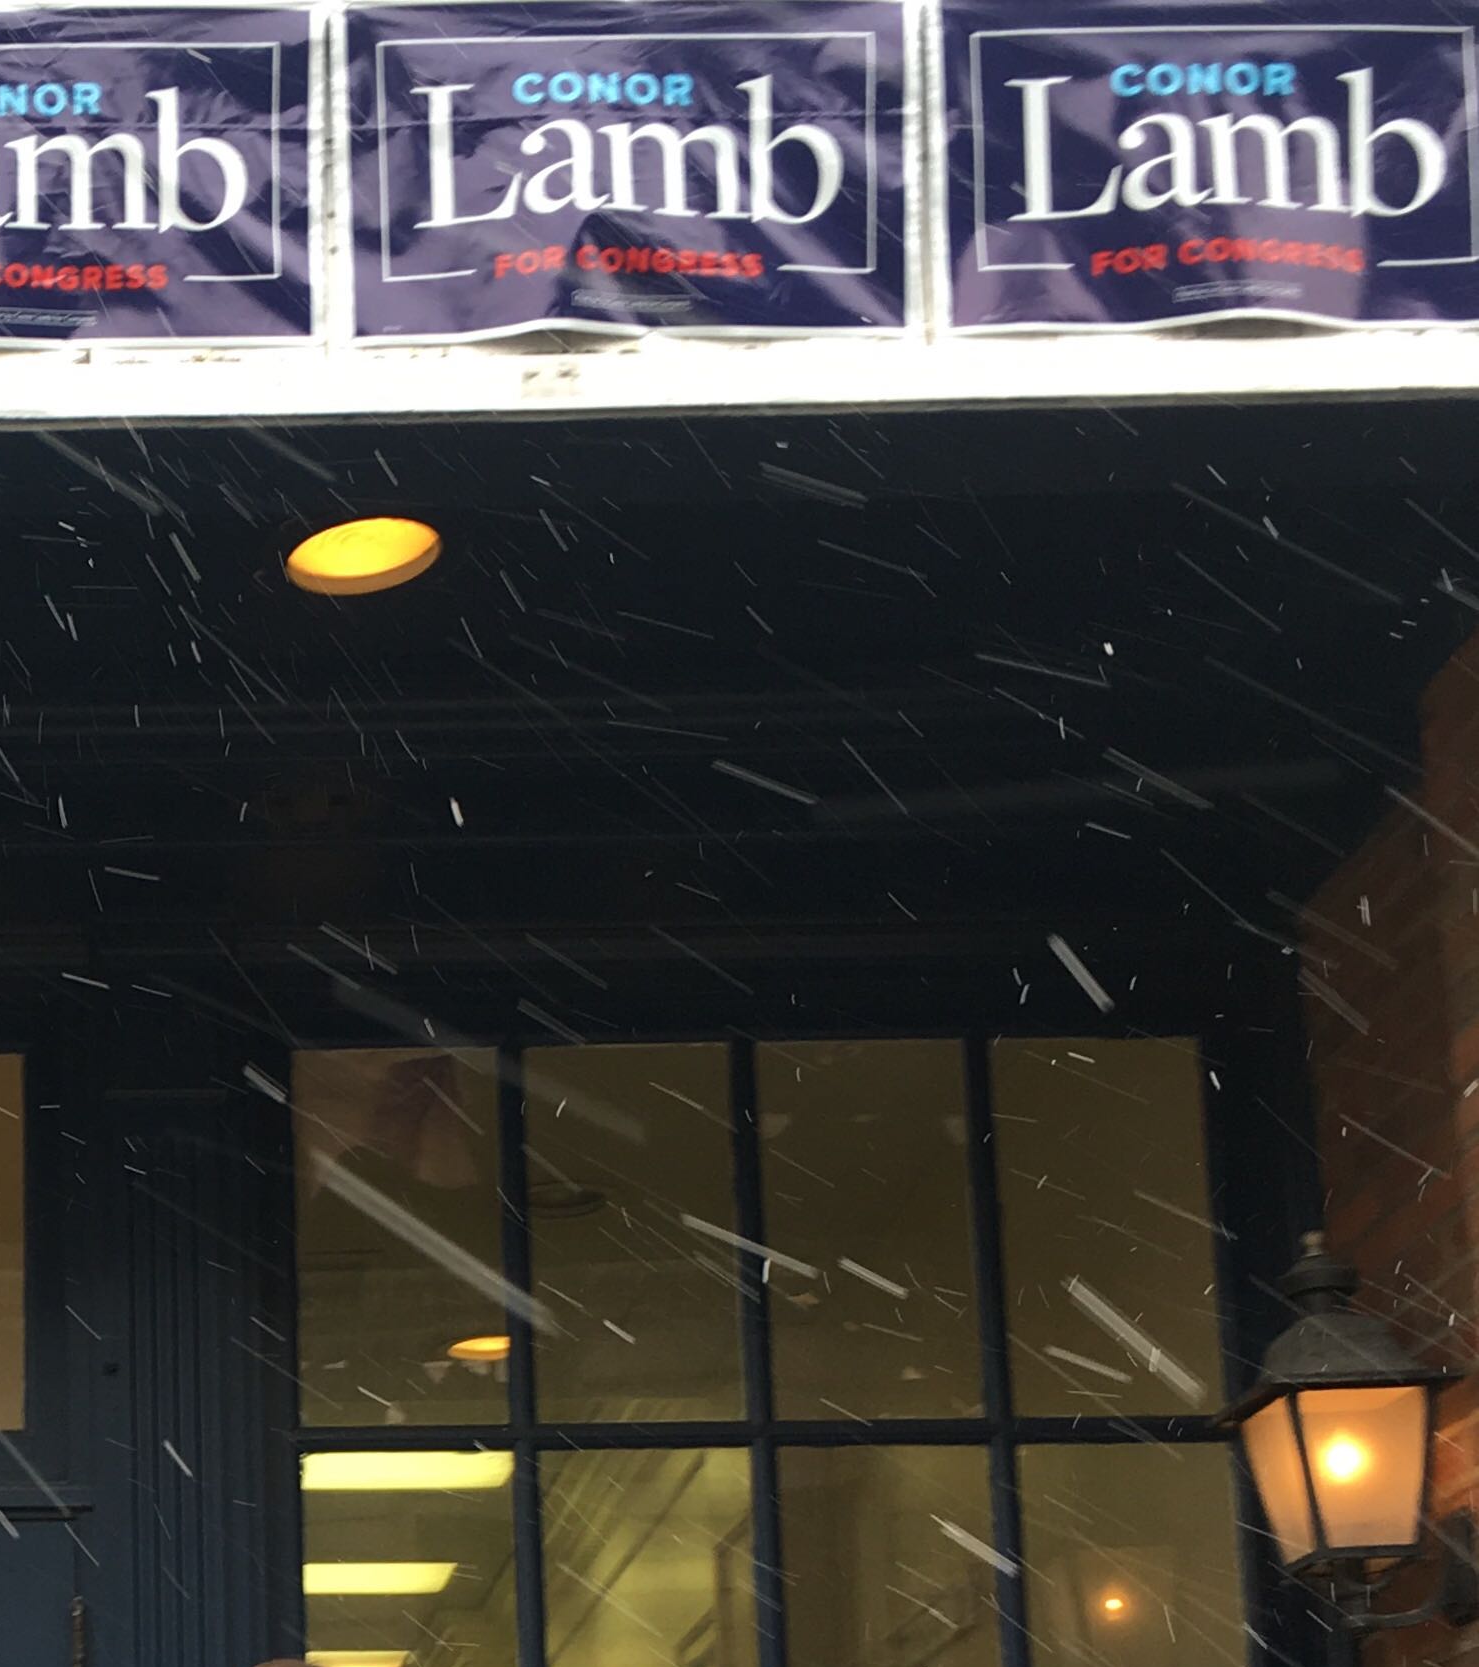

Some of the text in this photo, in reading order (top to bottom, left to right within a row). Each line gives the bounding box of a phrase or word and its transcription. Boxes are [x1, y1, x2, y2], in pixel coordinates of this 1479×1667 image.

[513, 72, 693, 106] CONOR
[1112, 63, 1295, 97] CONOR
[411, 75, 841, 228] Lamb
[1008, 69, 1445, 220] Lamb
[494, 245, 764, 278] FOR CONGRESS
[1092, 237, 1364, 276] FOR CONGRESS
